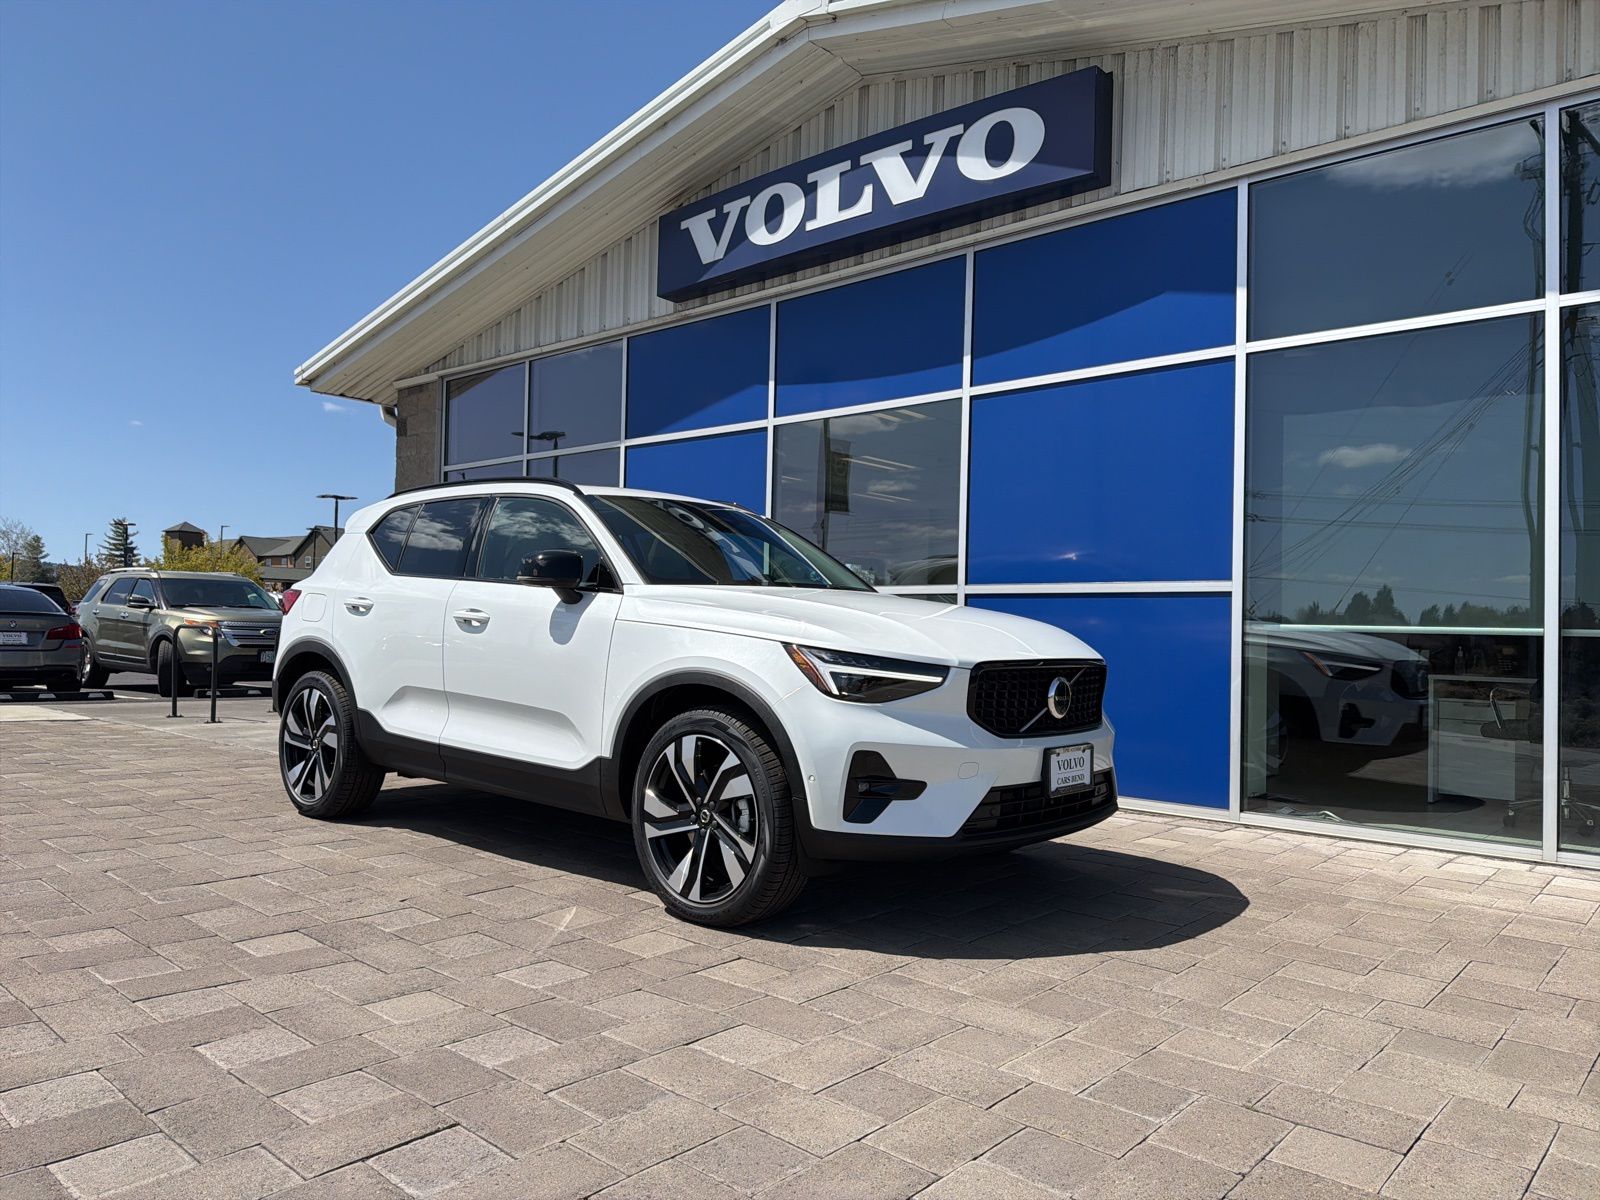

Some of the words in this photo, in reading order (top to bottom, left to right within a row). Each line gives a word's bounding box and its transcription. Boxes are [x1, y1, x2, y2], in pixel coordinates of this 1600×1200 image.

[680, 107, 1045, 264] VOLVO
[1057, 756, 1084, 771] VOLVO
[1057, 776, 1070, 785] CARS
